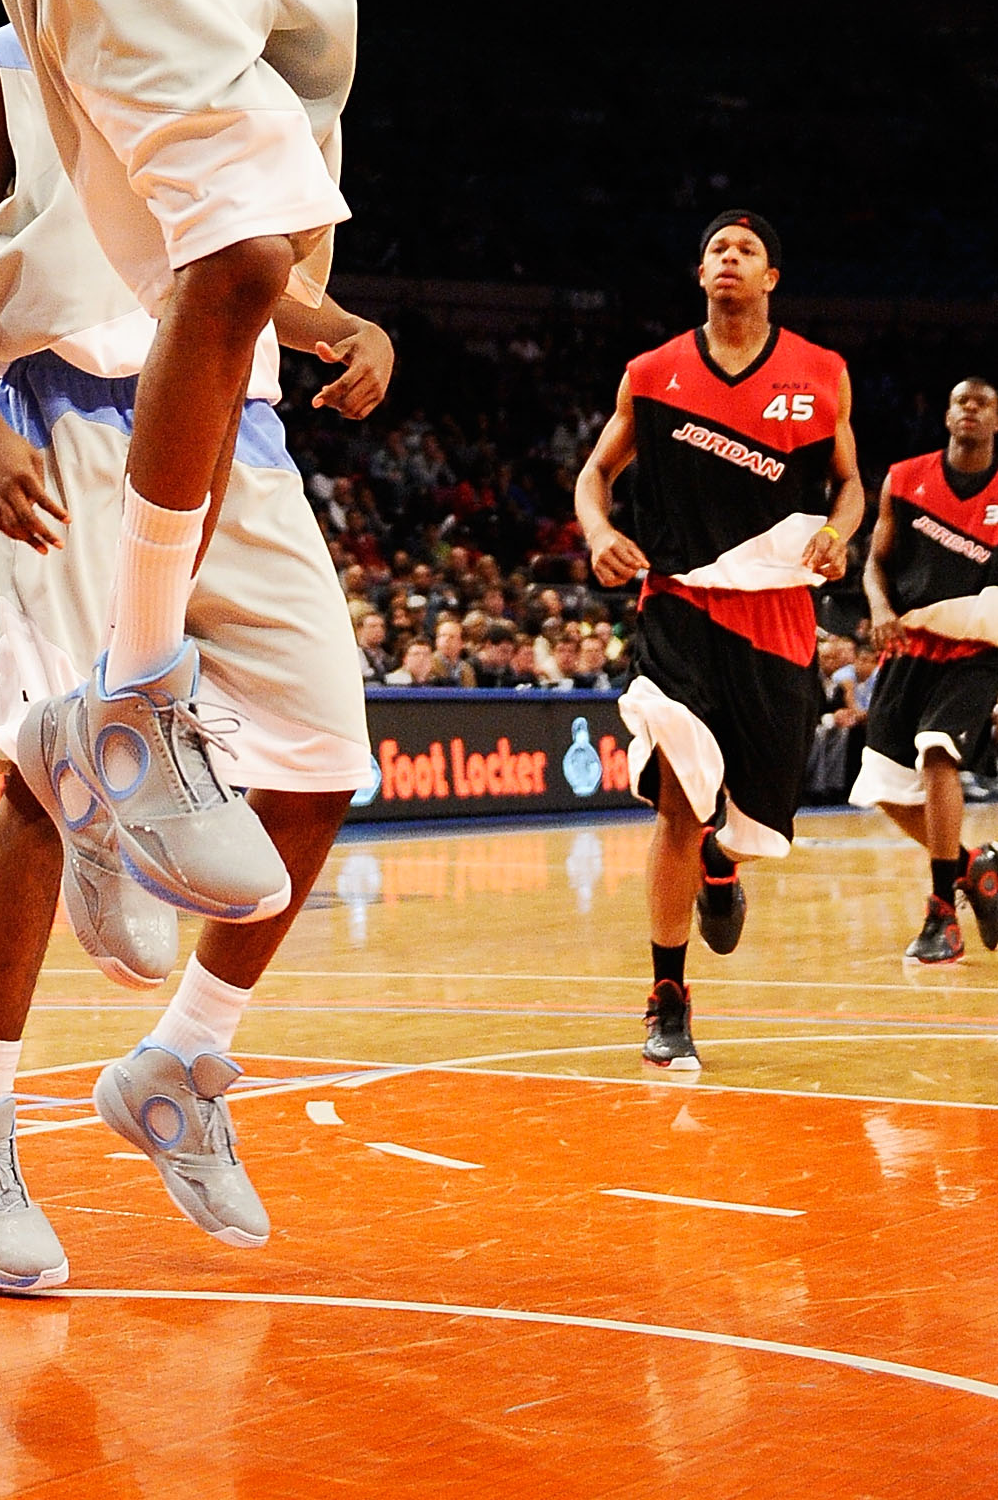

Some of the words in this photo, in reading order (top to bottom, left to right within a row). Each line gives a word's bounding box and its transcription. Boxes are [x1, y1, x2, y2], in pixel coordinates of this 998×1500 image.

[761, 392, 816, 422] 45
[671, 422, 786, 482] JORDAN
[911, 515, 992, 565] JORDAN
[379, 737, 450, 800] Foot
[451, 736, 547, 798] Locker
